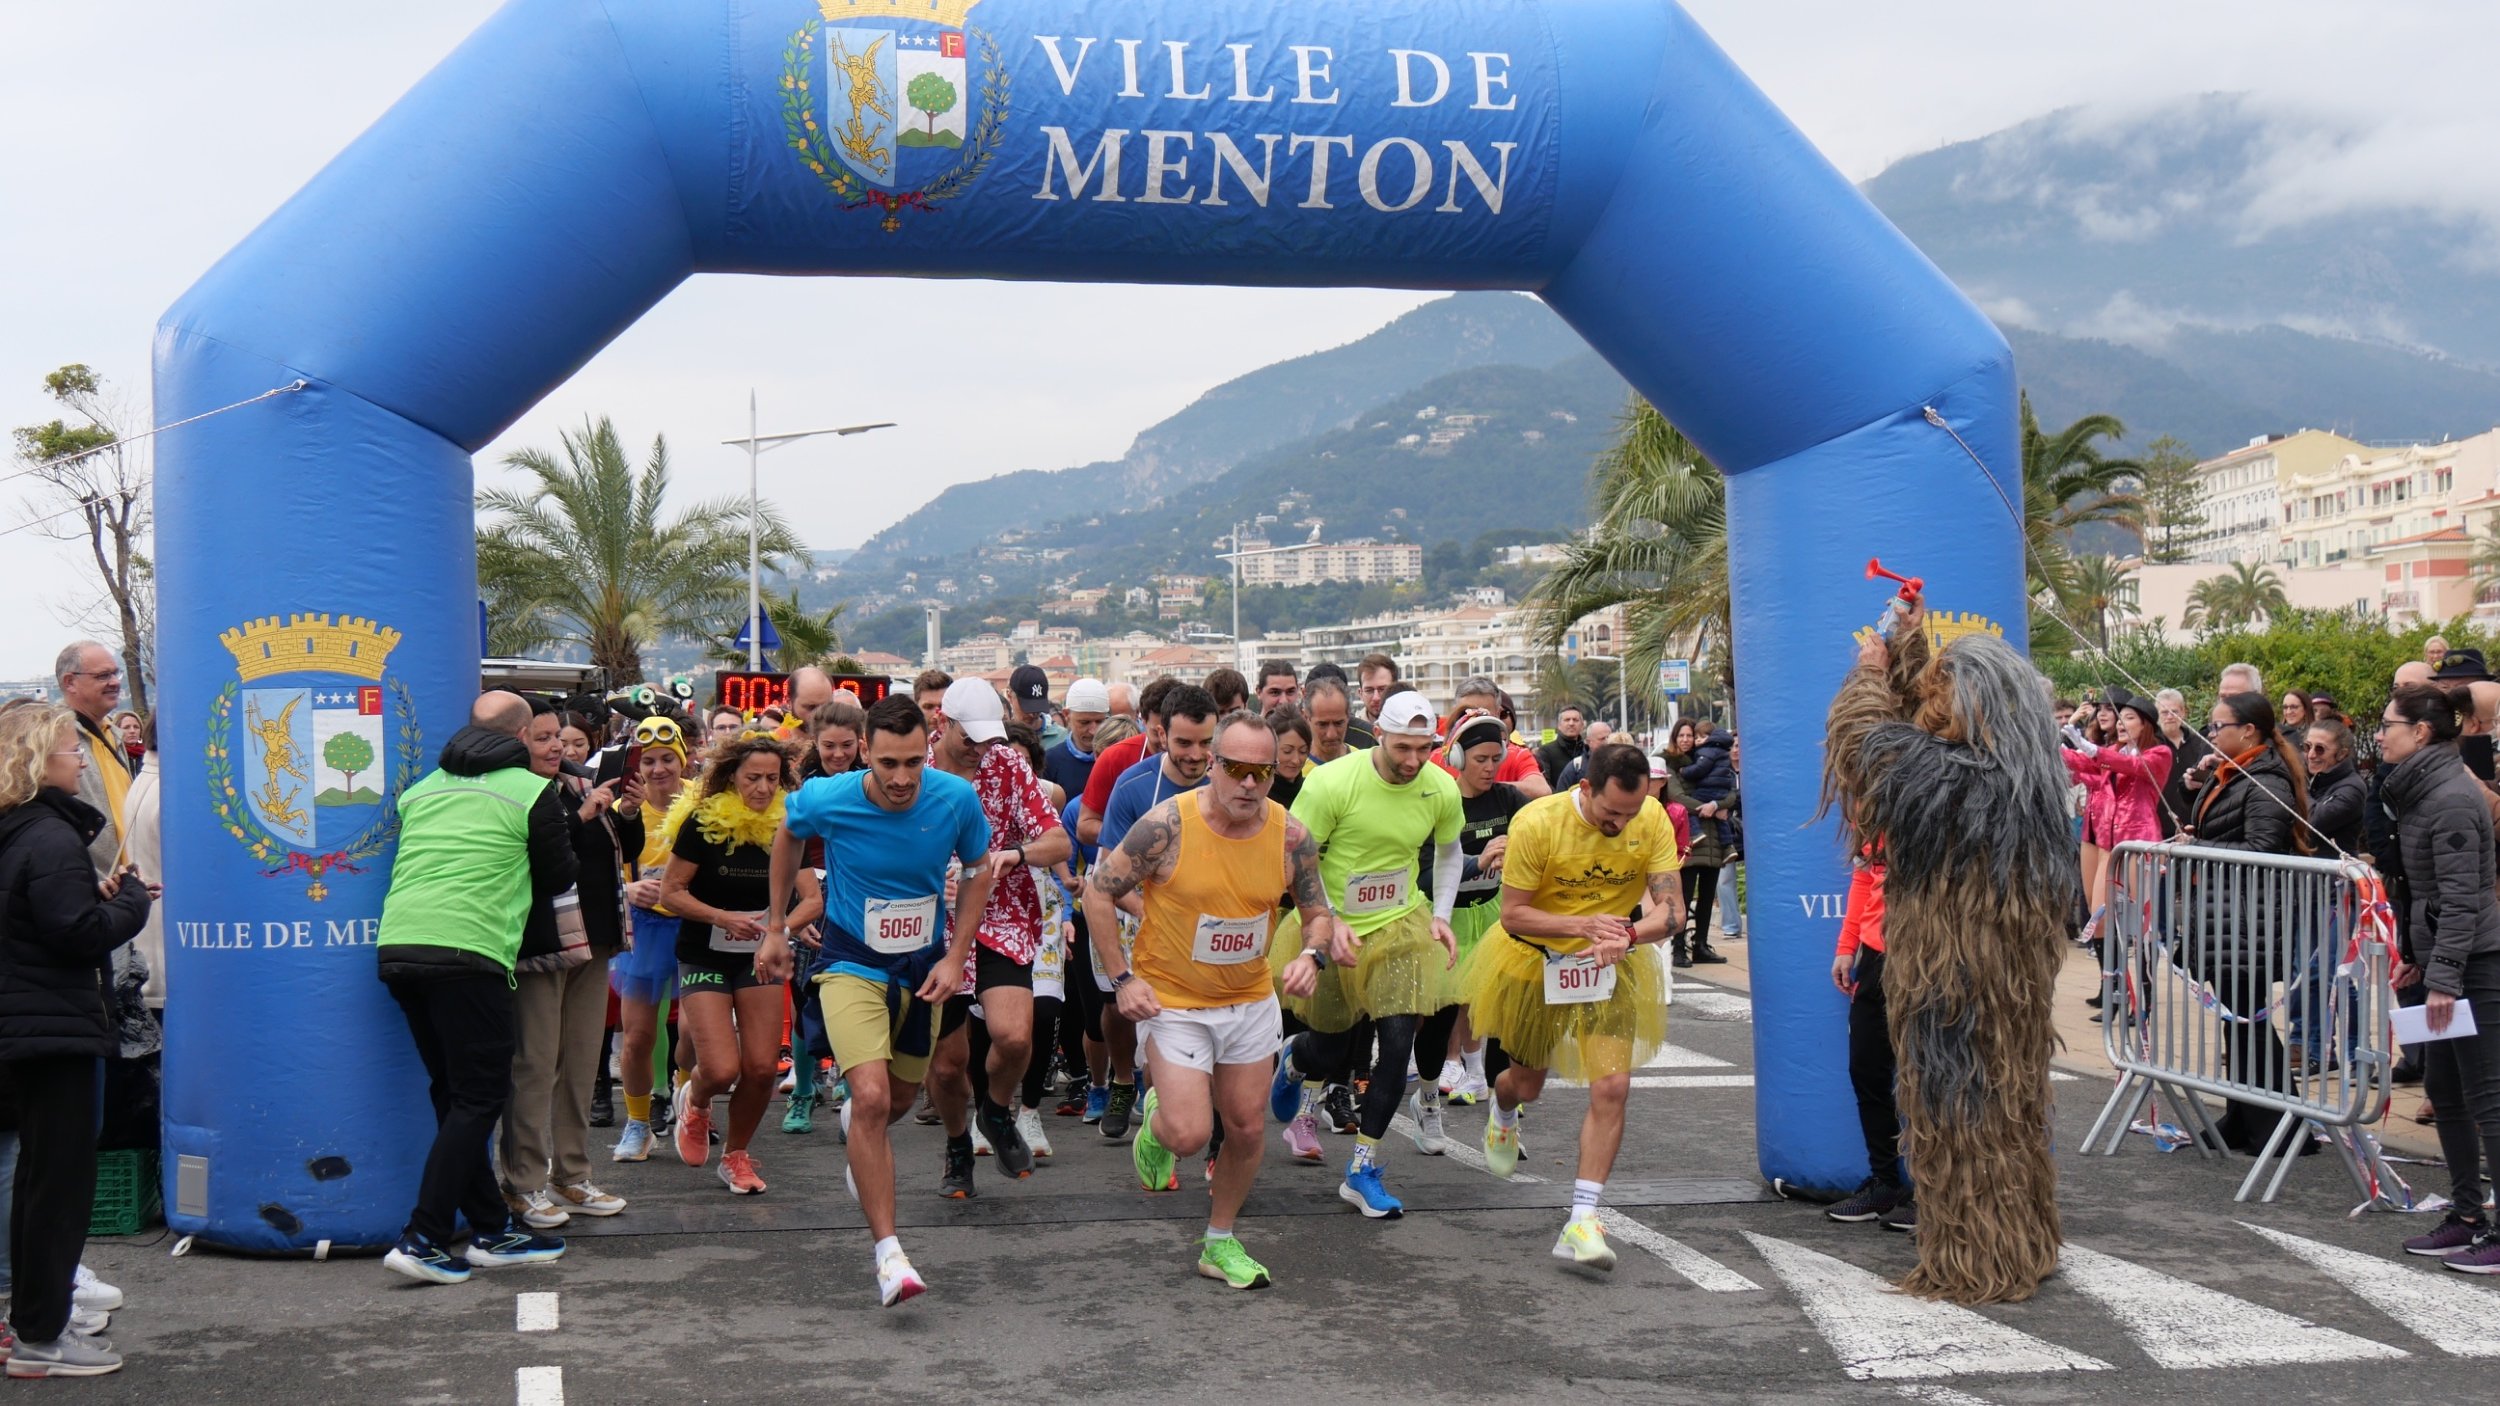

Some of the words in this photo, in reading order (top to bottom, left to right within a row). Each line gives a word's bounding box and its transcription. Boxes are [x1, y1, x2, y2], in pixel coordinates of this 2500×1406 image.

[1034, 35, 1341, 106] VILLE
[1388, 48, 1518, 111] DE
[1032, 126, 1518, 215] MENTON
[1475, 828, 1493, 839] ROXY
[1358, 883, 1396, 903] 5019
[176, 921, 253, 949] VILLE
[262, 921, 313, 948] DE
[879, 915, 922, 939] 5050
[1210, 932, 1254, 952] 5064
[680, 972, 724, 988] NIKE
[1559, 967, 1600, 989] 5017
